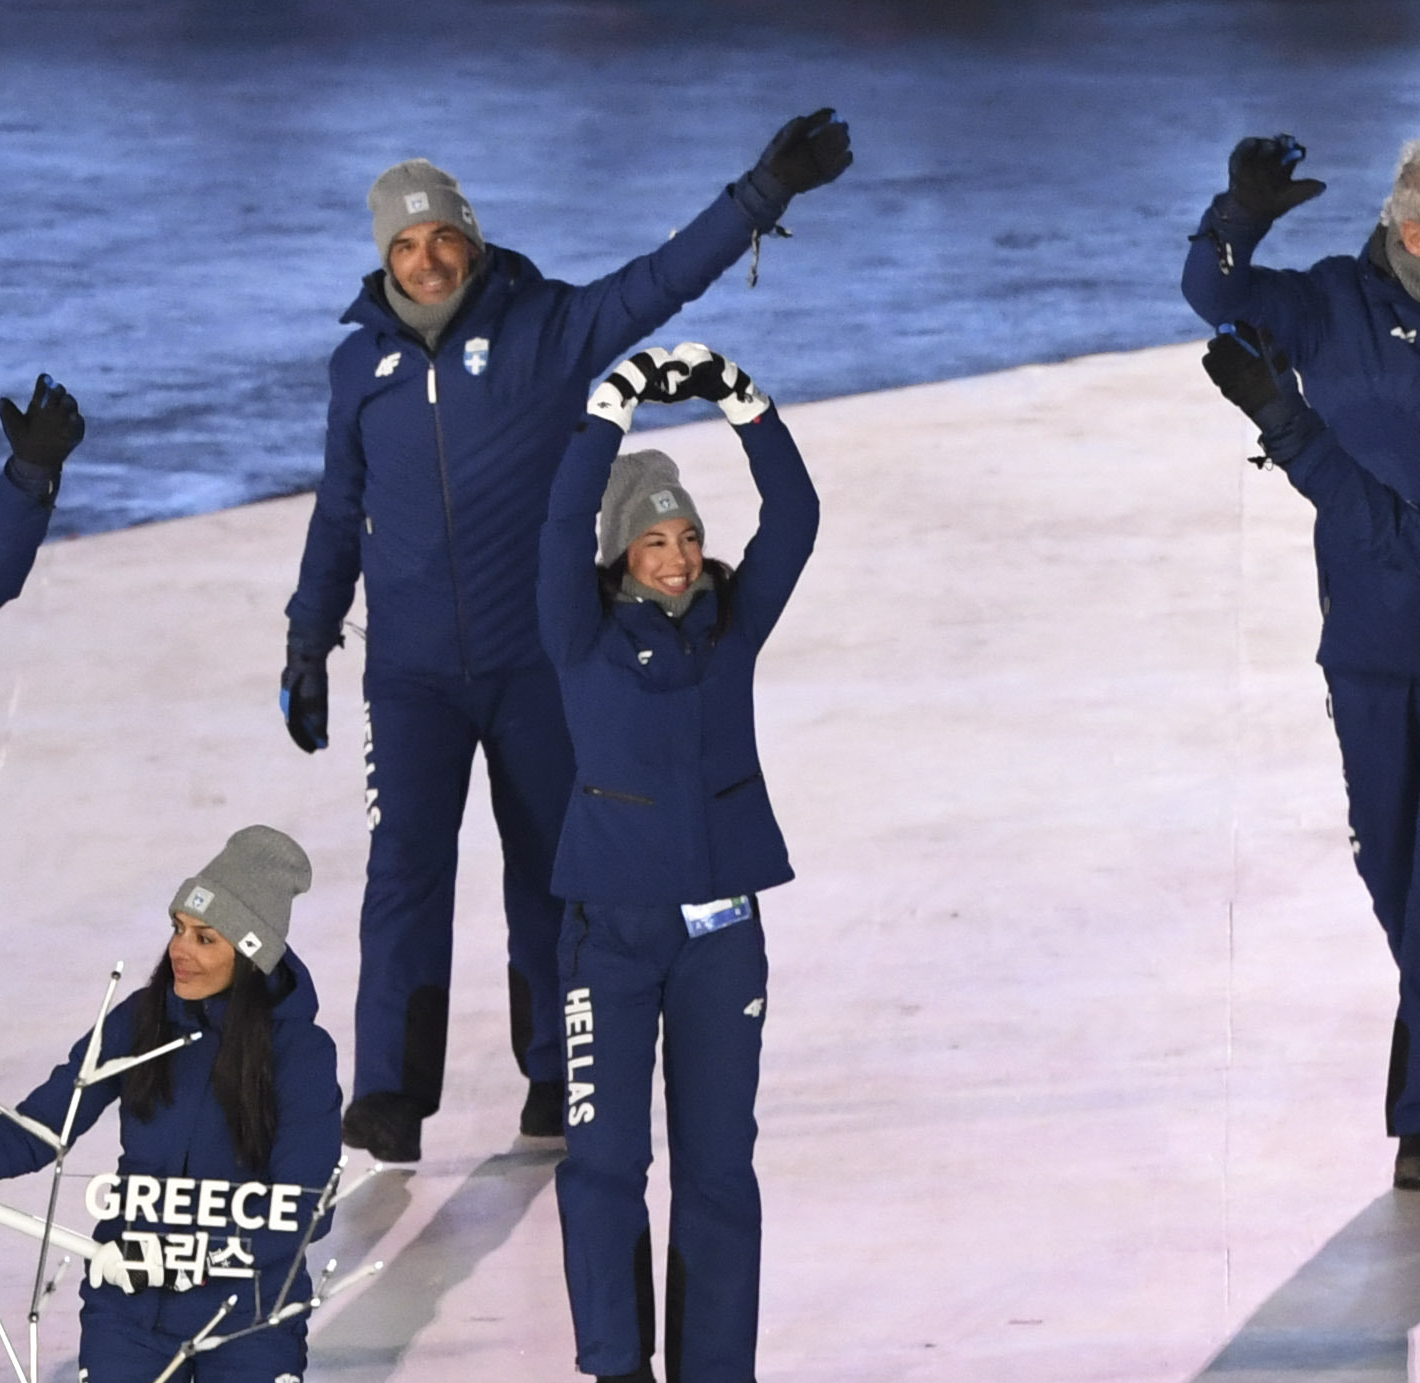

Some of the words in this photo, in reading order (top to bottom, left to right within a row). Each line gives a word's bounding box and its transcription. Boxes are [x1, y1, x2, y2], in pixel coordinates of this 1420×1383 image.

[565, 988, 595, 1127] HELLAS
[85, 1173, 302, 1231] GREECE
[119, 1232, 254, 1285] 그리스
